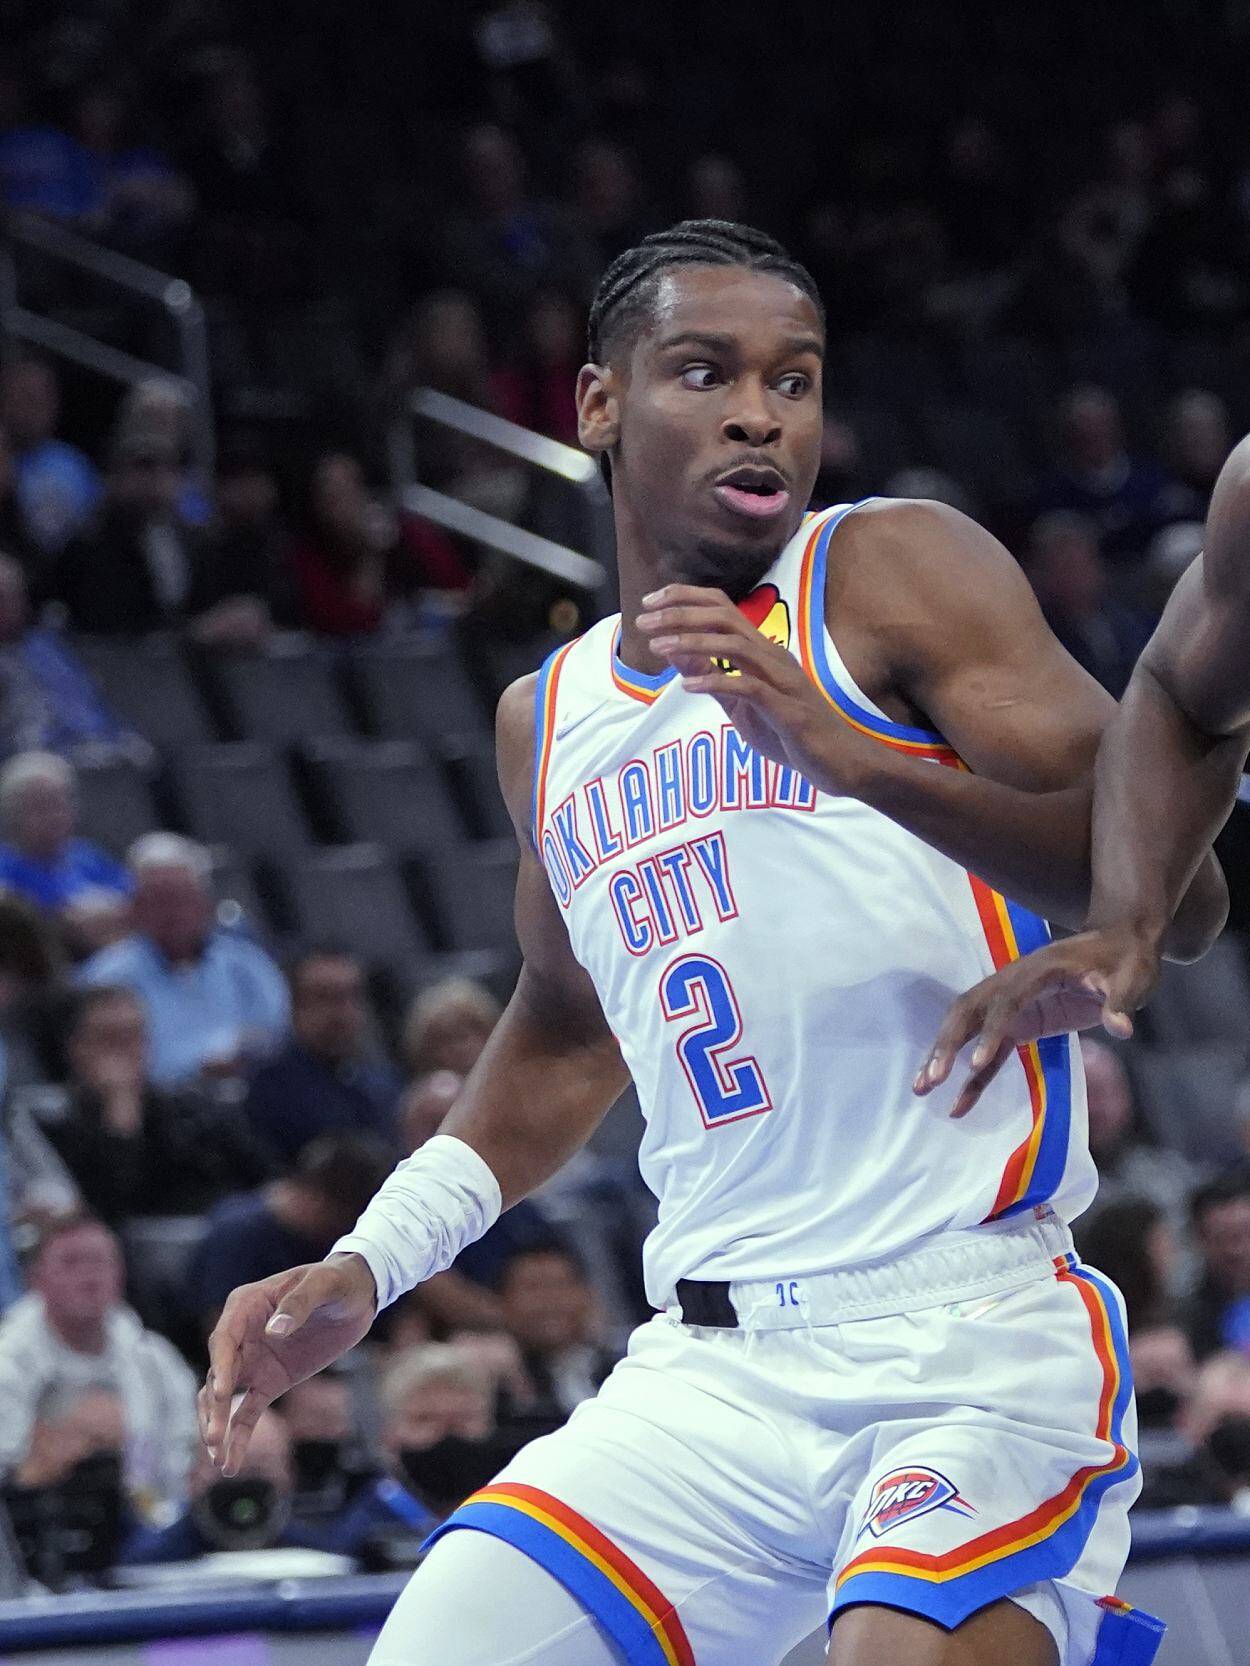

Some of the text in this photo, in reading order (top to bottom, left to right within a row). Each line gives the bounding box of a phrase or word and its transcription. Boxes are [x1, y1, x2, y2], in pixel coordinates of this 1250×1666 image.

[608, 830, 739, 957] CITY
[658, 952, 773, 1130] 2
[859, 1479, 935, 1533] OKC
